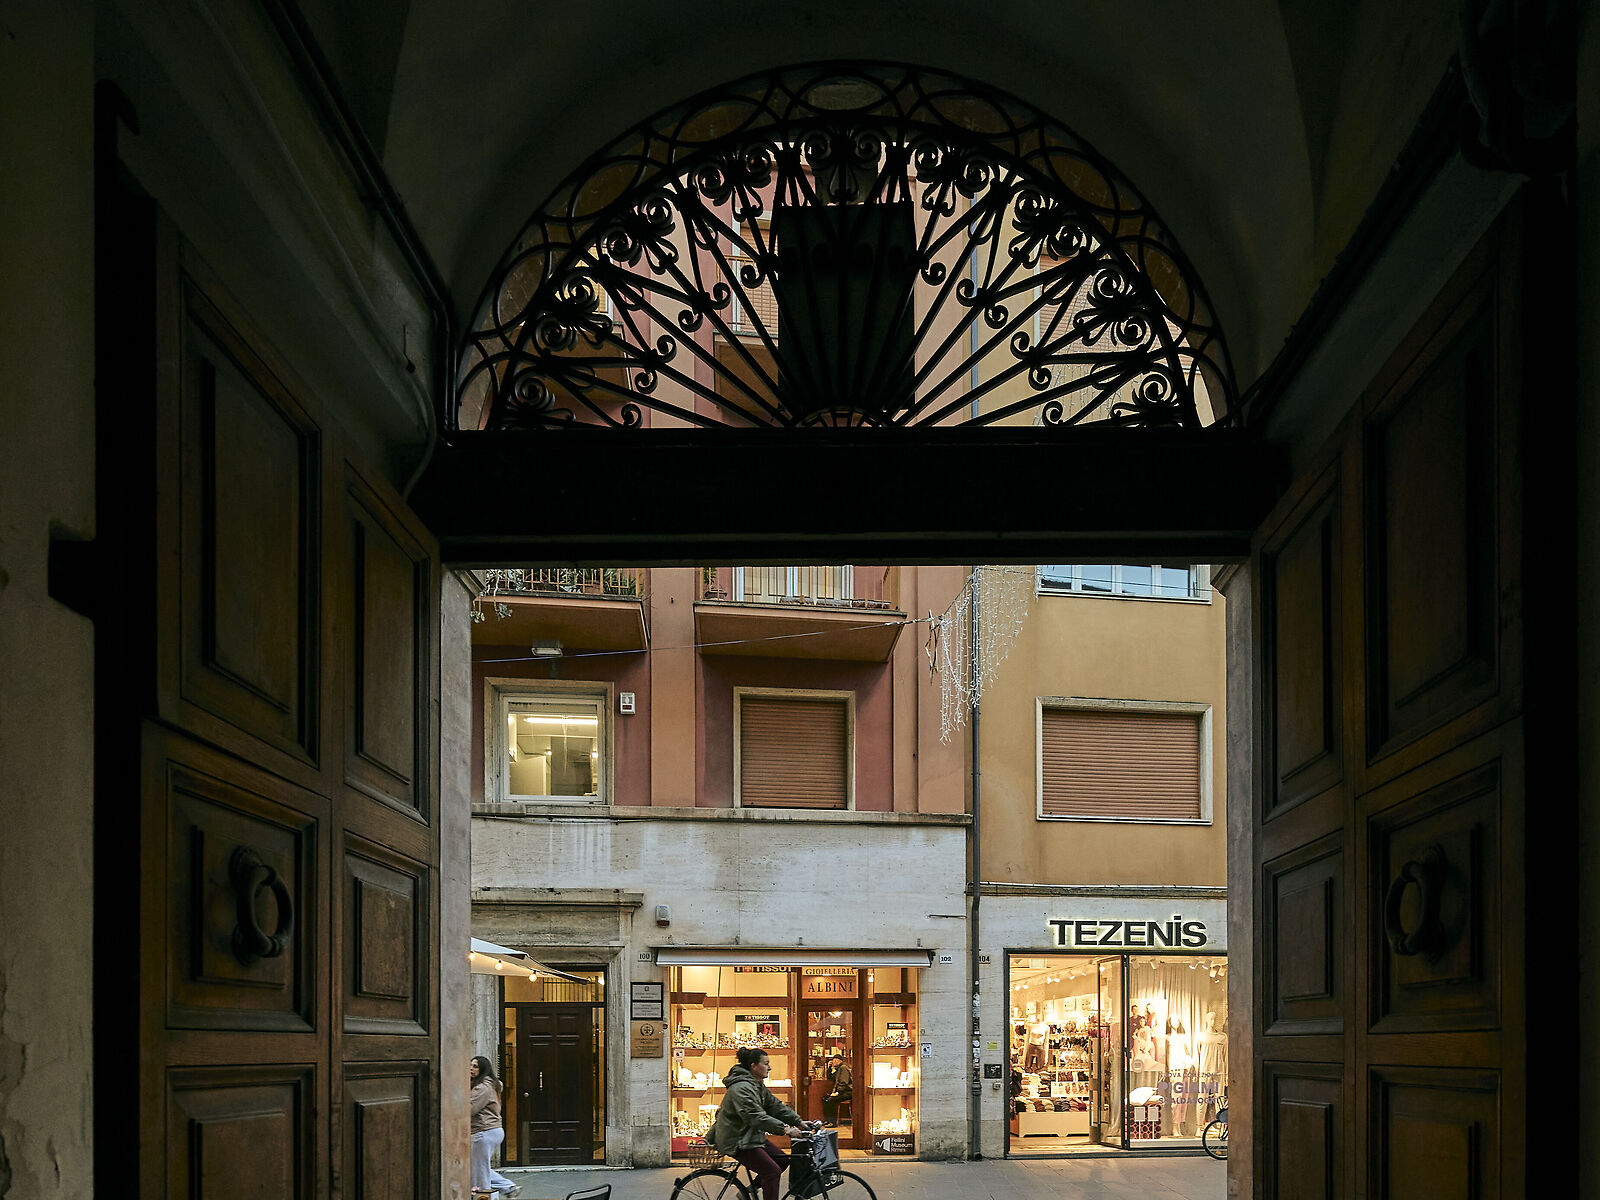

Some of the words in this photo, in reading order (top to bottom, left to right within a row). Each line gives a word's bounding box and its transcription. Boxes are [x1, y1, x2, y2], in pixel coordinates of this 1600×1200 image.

[639, 952, 651, 960] 100
[808, 982, 853, 992] ALBINI
[1158, 1082, 1218, 1093] PIGIAMI
